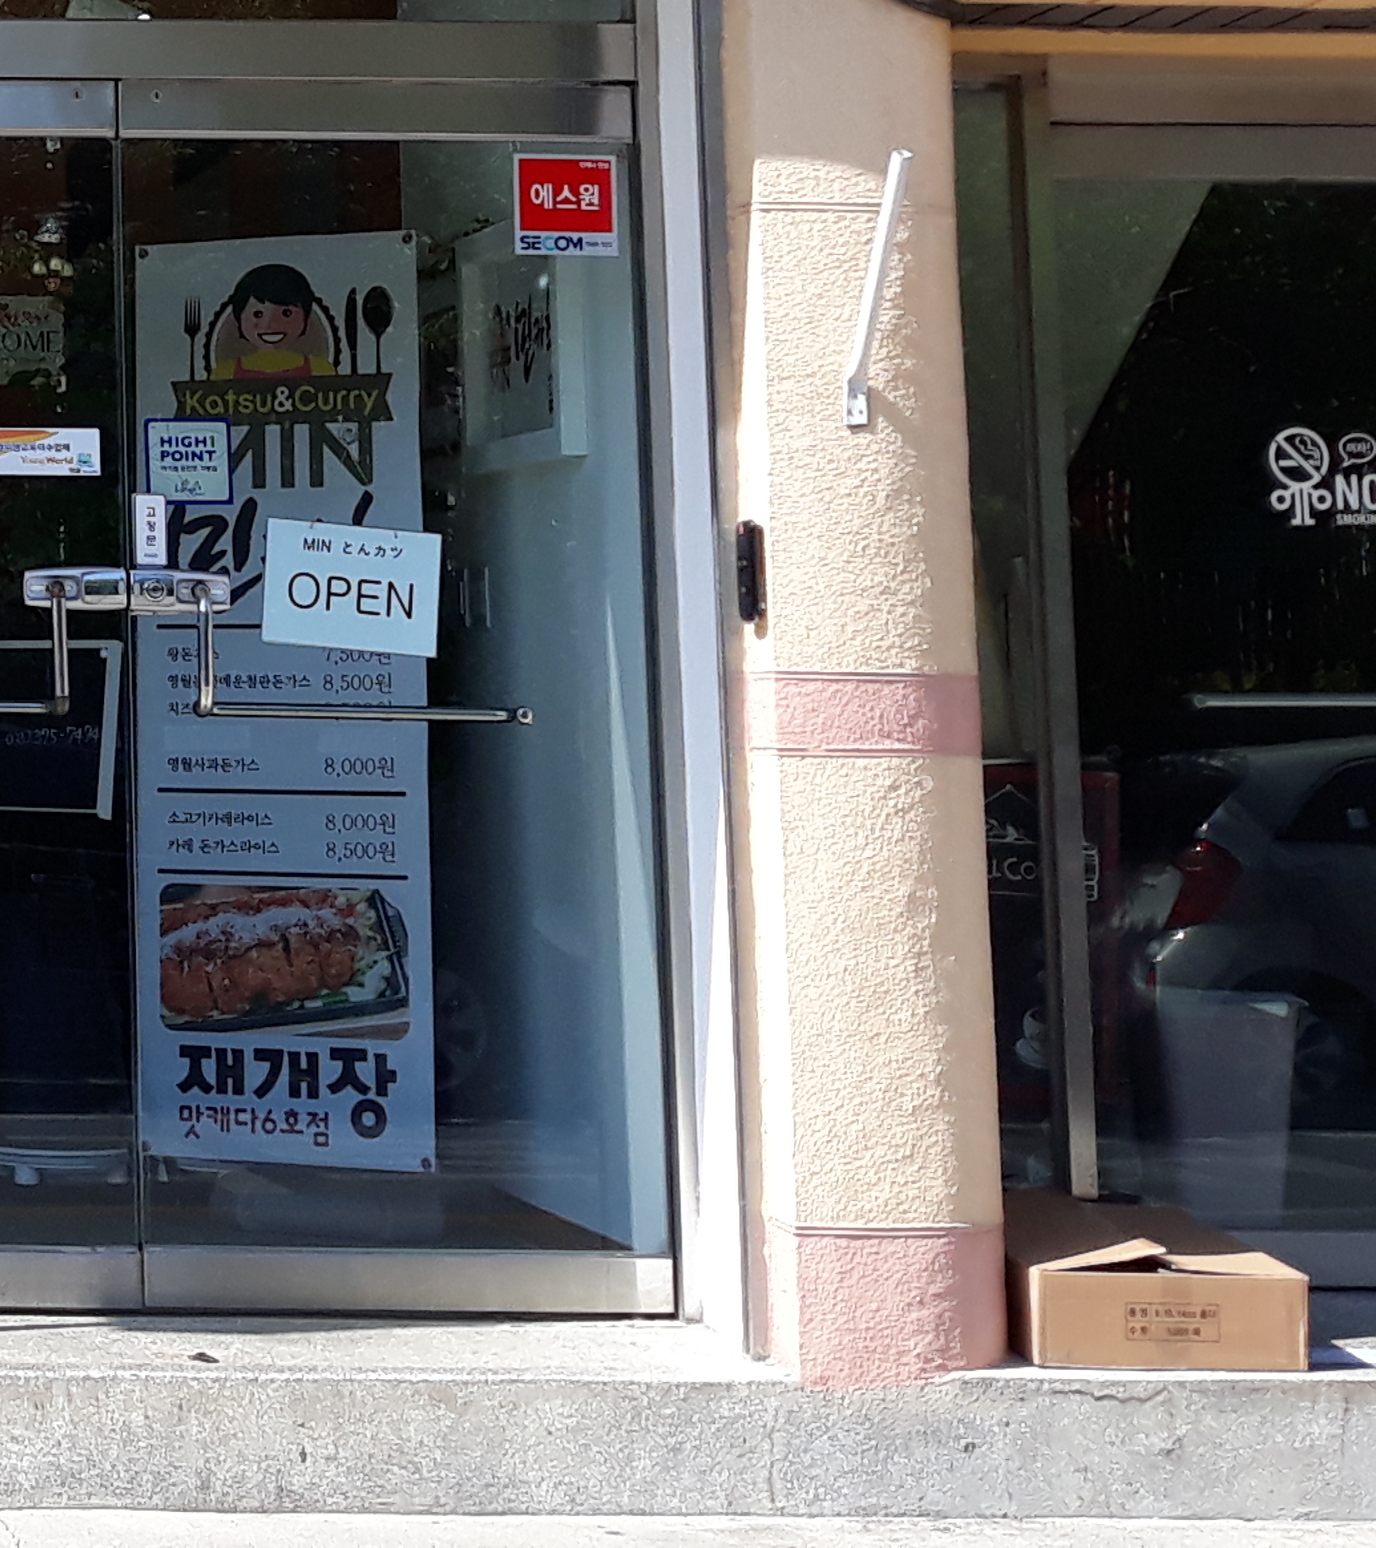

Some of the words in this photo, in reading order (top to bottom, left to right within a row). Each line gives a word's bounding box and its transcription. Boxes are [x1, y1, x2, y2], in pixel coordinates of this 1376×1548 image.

[529, 182, 601, 211] 에스원
[519, 235, 584, 252] SECOM
[185, 385, 380, 416] Katsu&Curry
[159, 435, 216, 449] HIGH1
[159, 449, 217, 463] POINT
[145, 506, 157, 547] 고정문
[302, 537, 333, 553] MIN
[342, 541, 404, 559] とんカツ
[288, 571, 415, 620] OPEN
[322, 674, 393, 695] 8,500원
[323, 756, 396, 779] 8,000원
[324, 812, 397, 836] 8,000원
[324, 841, 397, 864] 8,500원
[175, 1043, 398, 1140] 재개장
[178, 1103, 331, 1148] 맛캐다6호점
